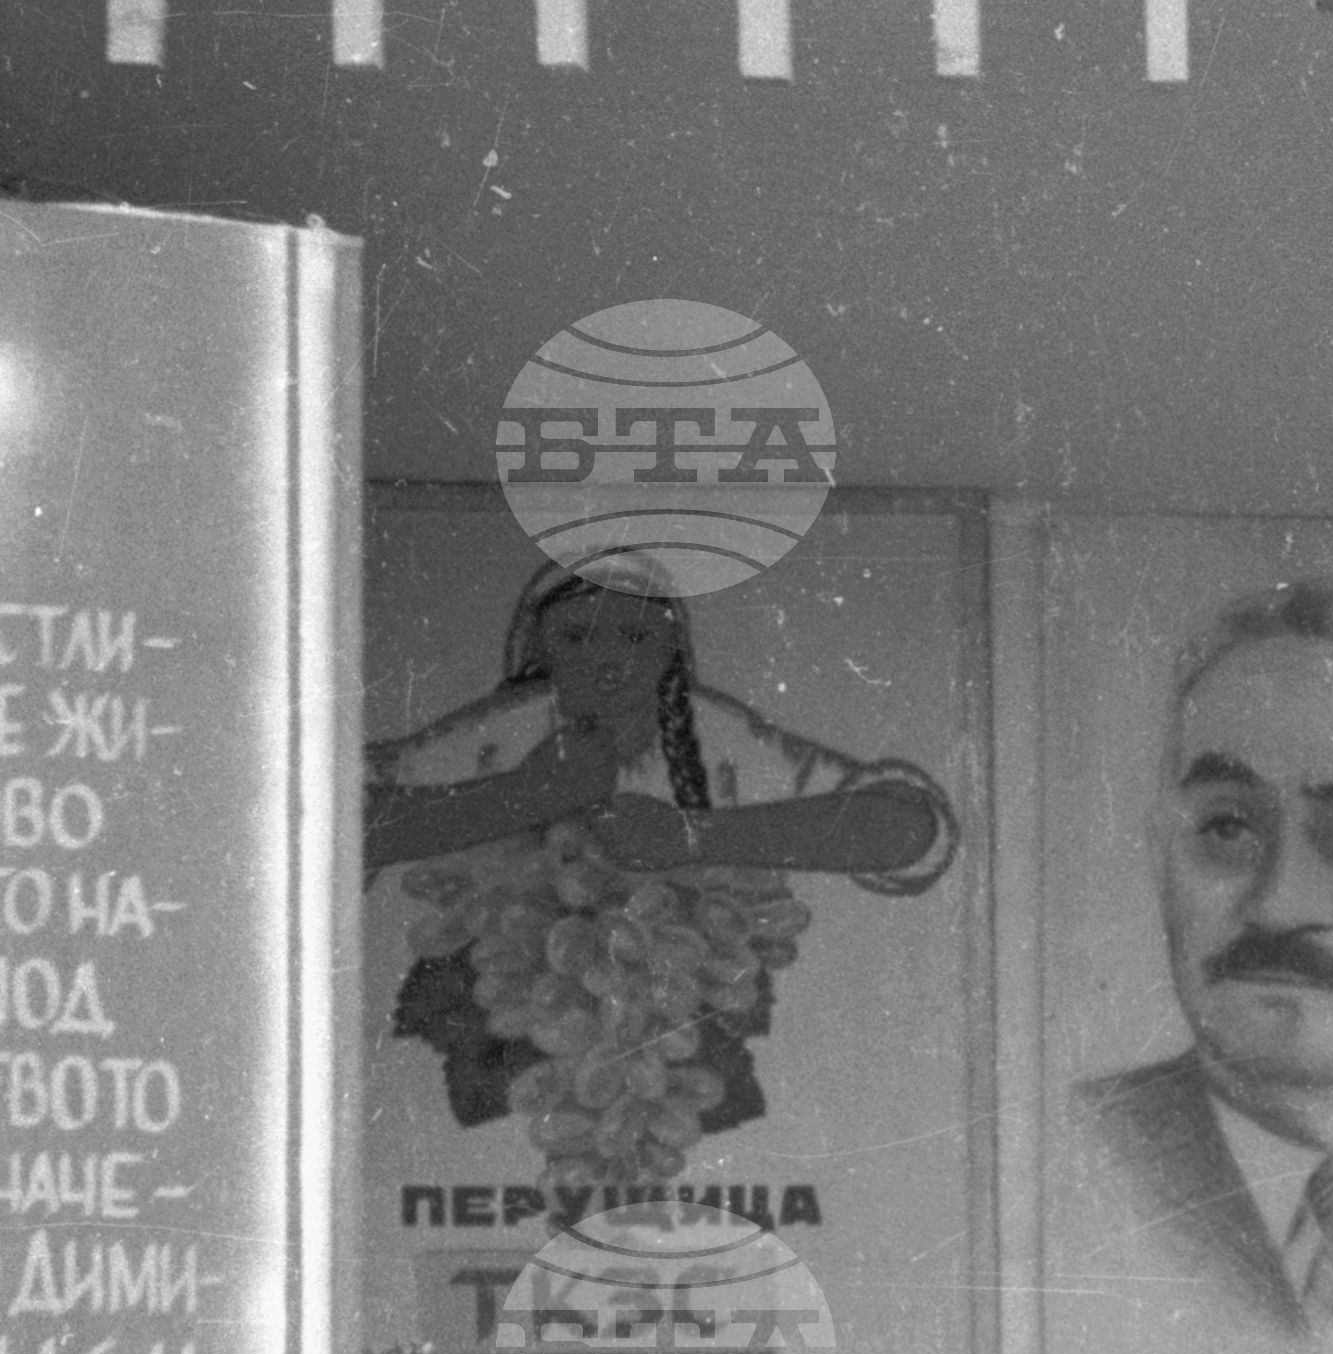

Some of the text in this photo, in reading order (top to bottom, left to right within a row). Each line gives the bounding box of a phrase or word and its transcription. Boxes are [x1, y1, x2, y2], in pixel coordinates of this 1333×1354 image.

[0, 867, 52, 936] О
[0, 955, 117, 1040] ОД
[0, 1051, 182, 1133] ВОТО
